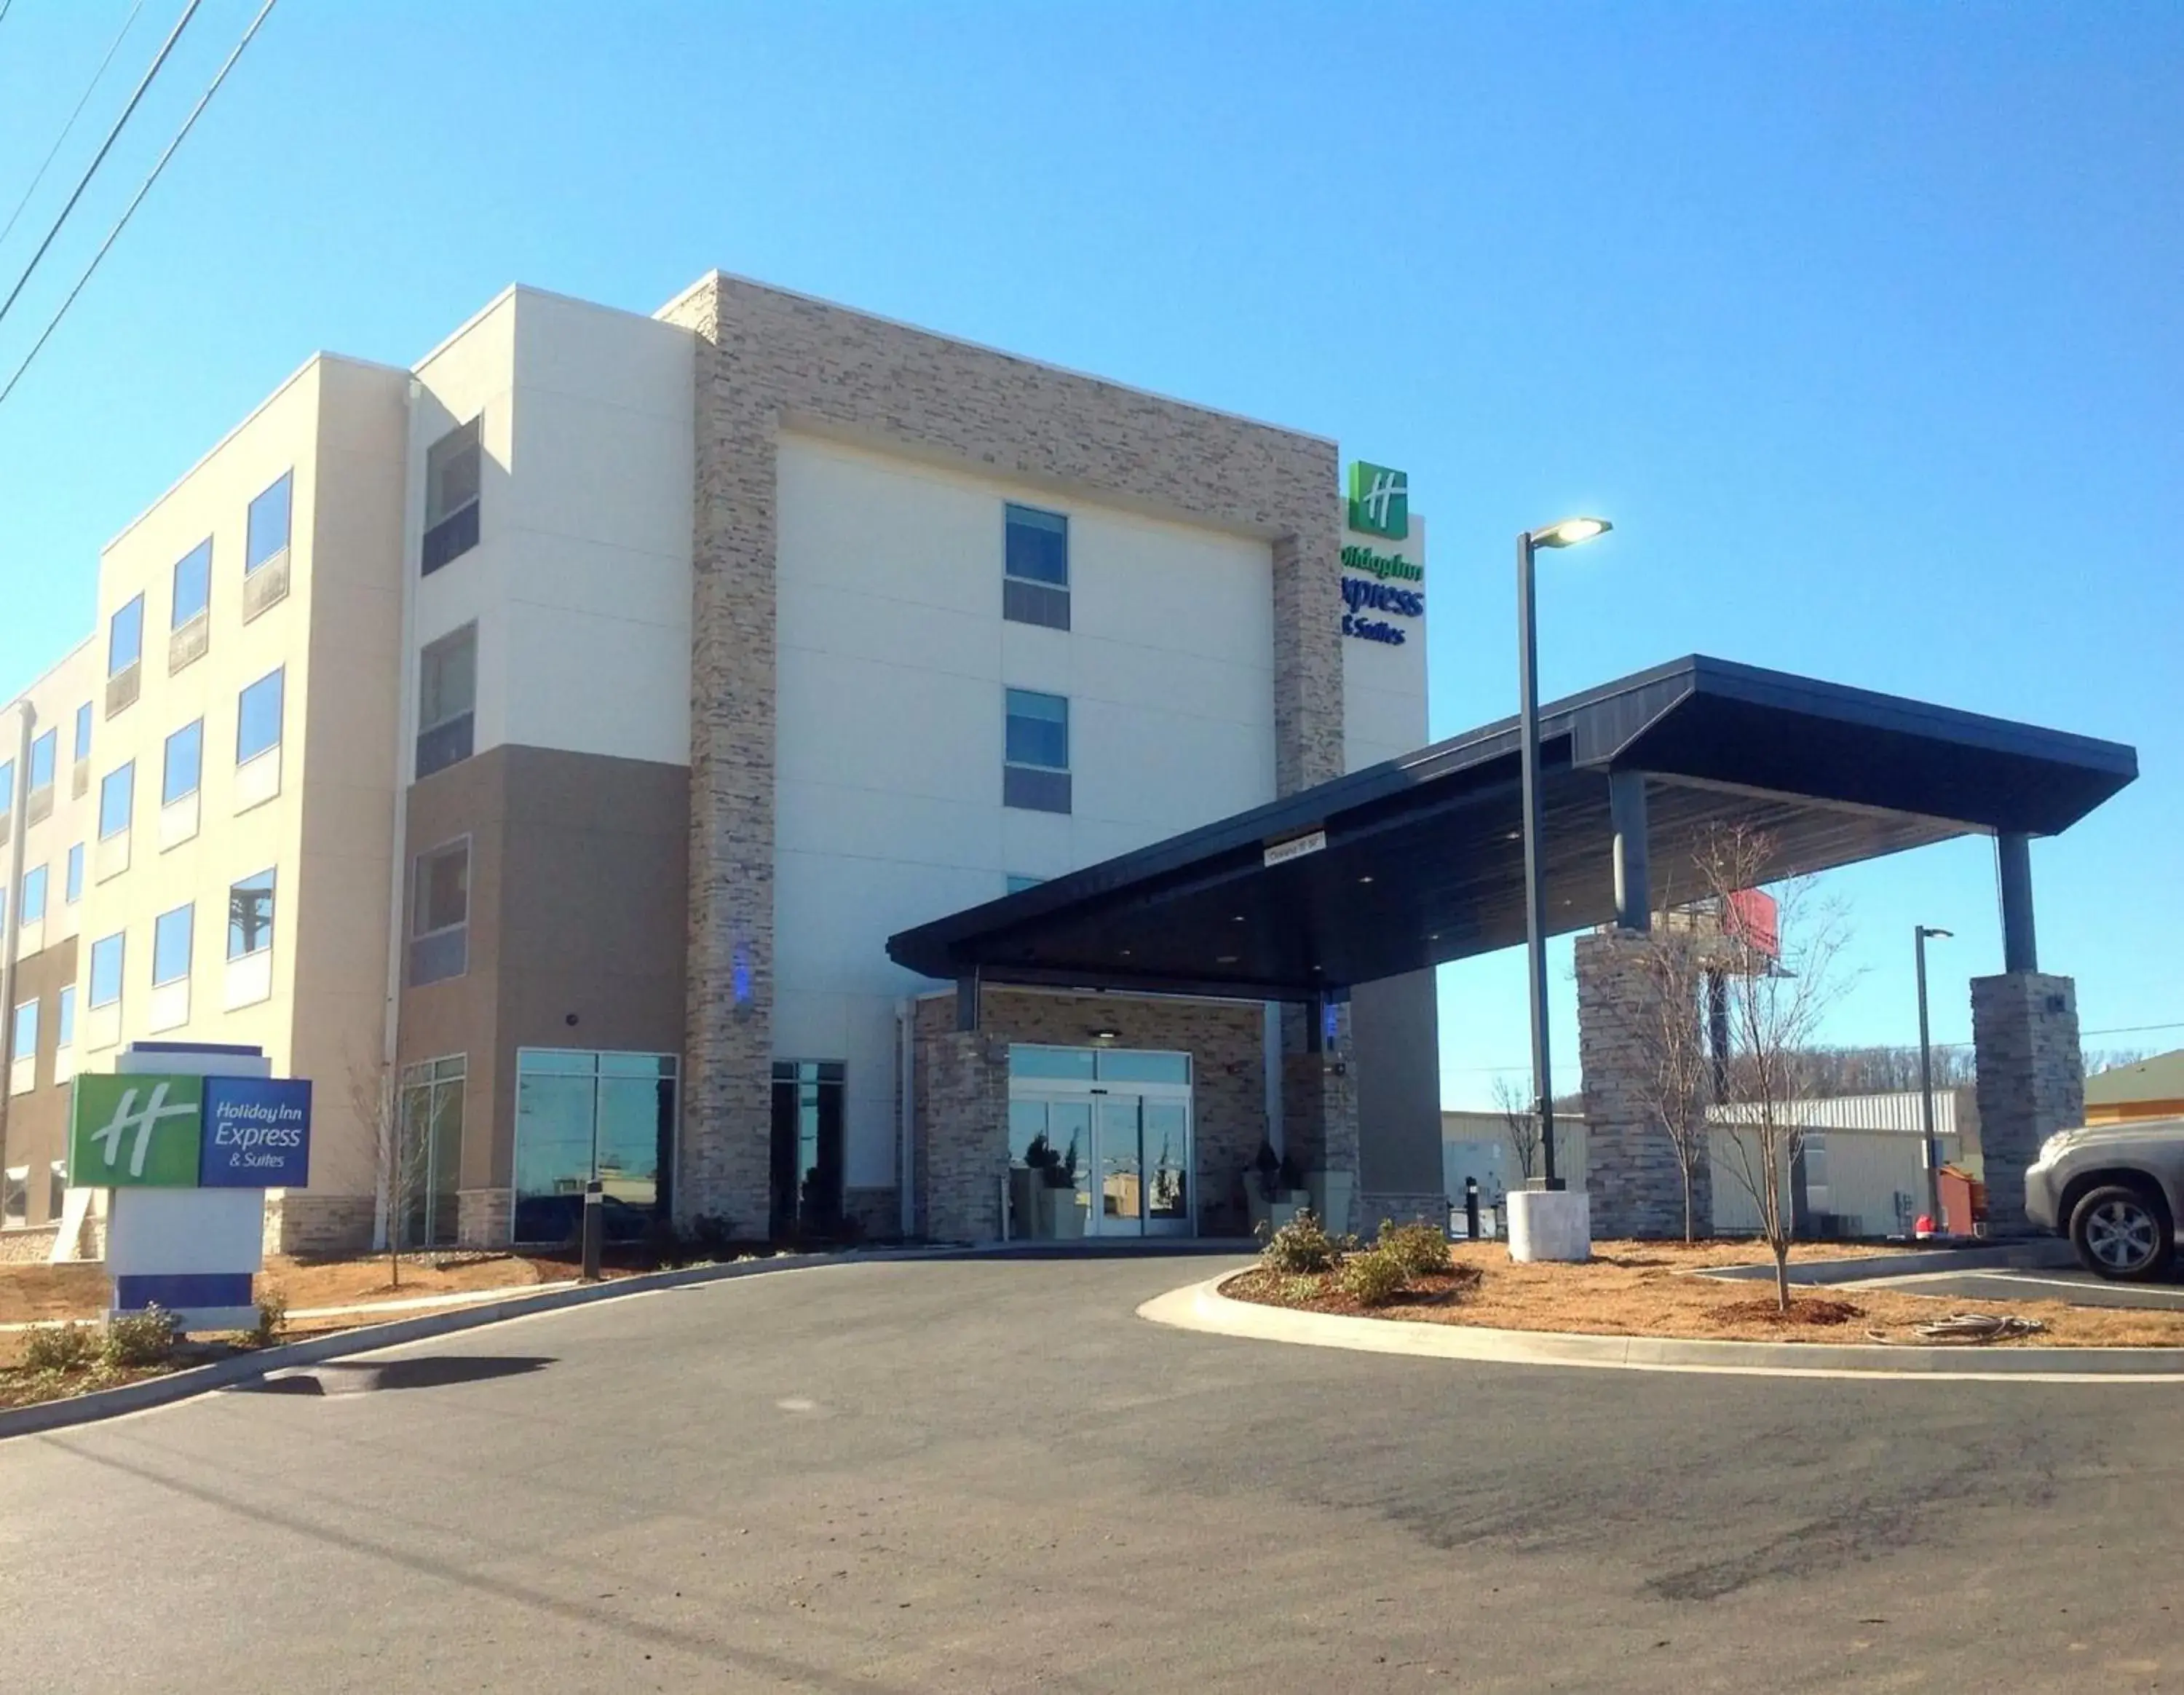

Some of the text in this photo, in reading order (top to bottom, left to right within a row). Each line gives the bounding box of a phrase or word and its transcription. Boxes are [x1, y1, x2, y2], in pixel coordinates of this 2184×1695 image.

[1392, 553, 1425, 582] Inn
[1341, 576, 1425, 617] xpress
[1353, 617, 1406, 647] Suites
[216, 1102, 303, 1123] Holiday Inn
[215, 1122, 303, 1151] Express
[229, 1152, 285, 1168] & Suites
